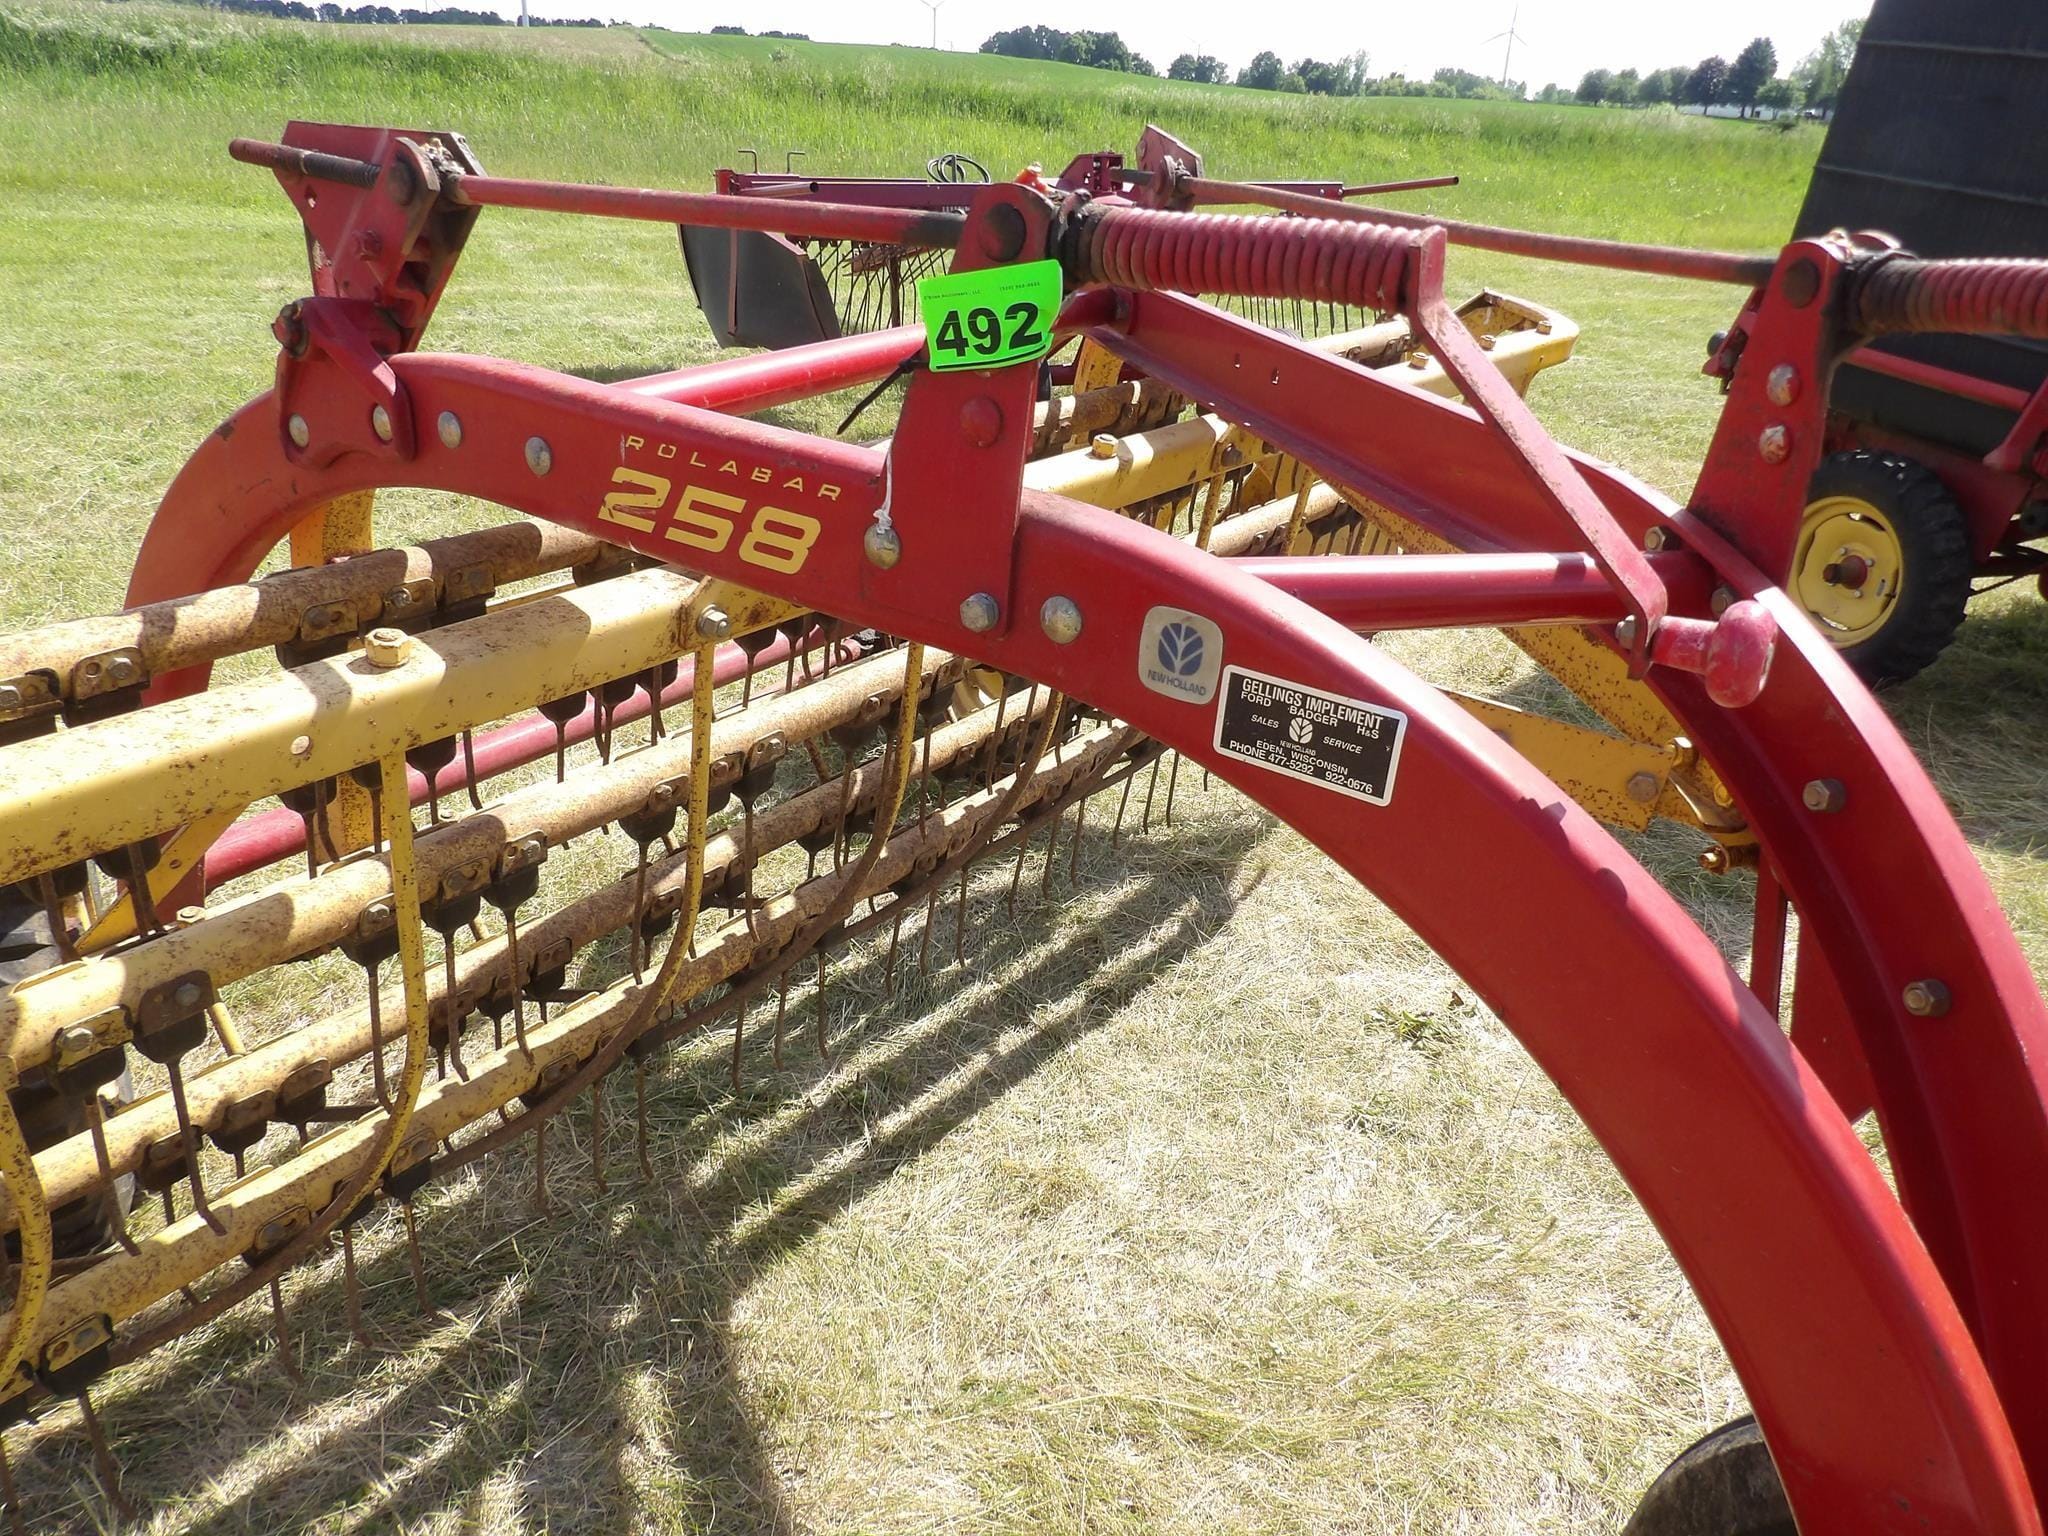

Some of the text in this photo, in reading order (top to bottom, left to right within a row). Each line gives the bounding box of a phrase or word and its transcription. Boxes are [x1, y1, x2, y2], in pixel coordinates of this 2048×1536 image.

[936, 302, 1042, 357] 492
[625, 435, 842, 501] ROLABAR
[598, 466, 822, 575] 258
[1148, 669, 1207, 696] NEW HOLLAND
[1241, 691, 1272, 708] FORD
[1242, 678, 1384, 730] GELLINGS IMPLEMENT
[1250, 714, 1280, 730] SALES
[1356, 724, 1380, 740] H&S
[1279, 740, 1317, 757] NEW HOLLAND
[1322, 736, 1363, 755] SERVICE
[1229, 740, 1373, 795] PHONE 477-5292 922-0676
[1291, 751, 1349, 776] WISCONSIN
